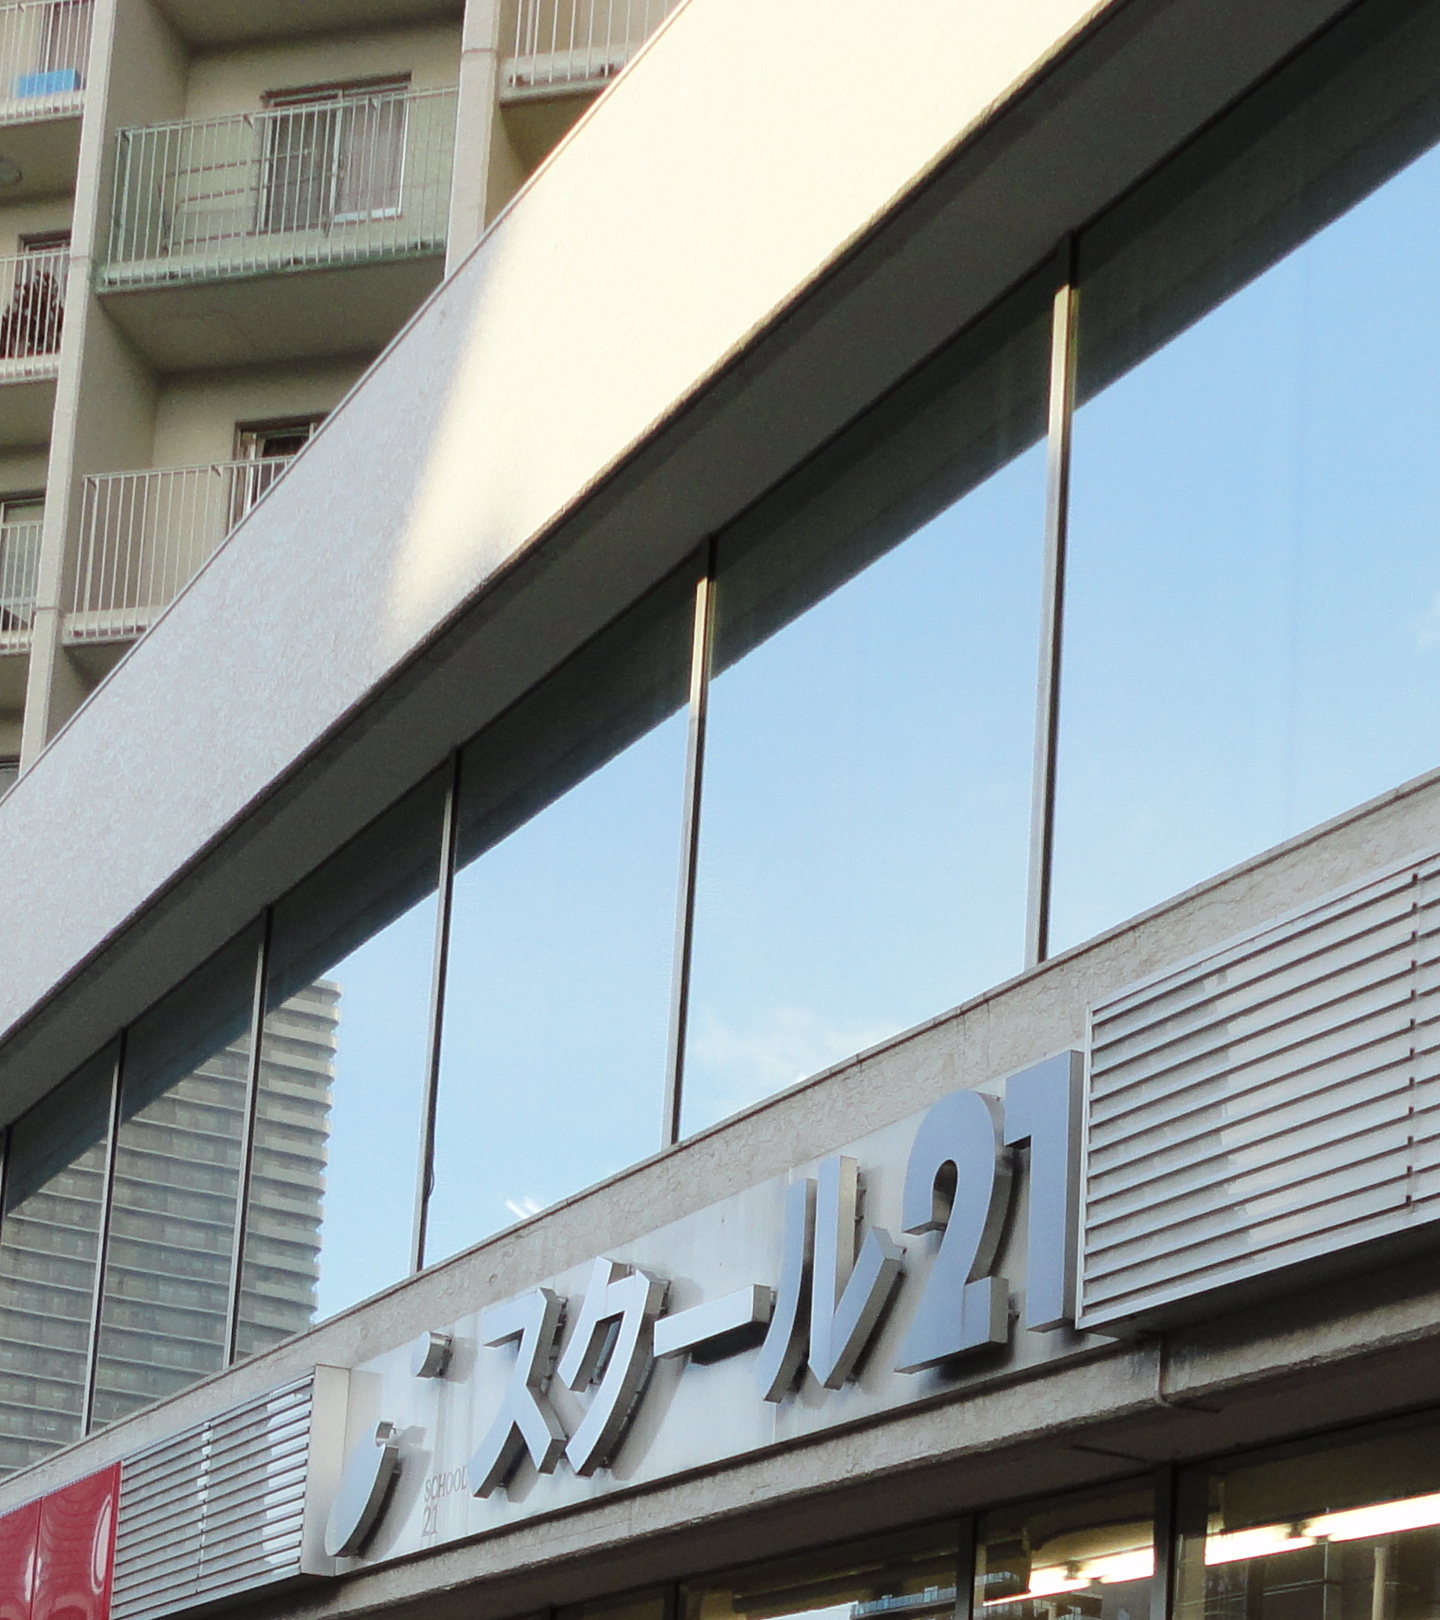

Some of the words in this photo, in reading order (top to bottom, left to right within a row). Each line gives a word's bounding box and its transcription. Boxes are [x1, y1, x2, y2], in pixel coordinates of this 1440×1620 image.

[472, 1049, 1083, 1500] スクール21
[423, 1465, 467, 1502] SCHOOL
[421, 1504, 438, 1537] 21
